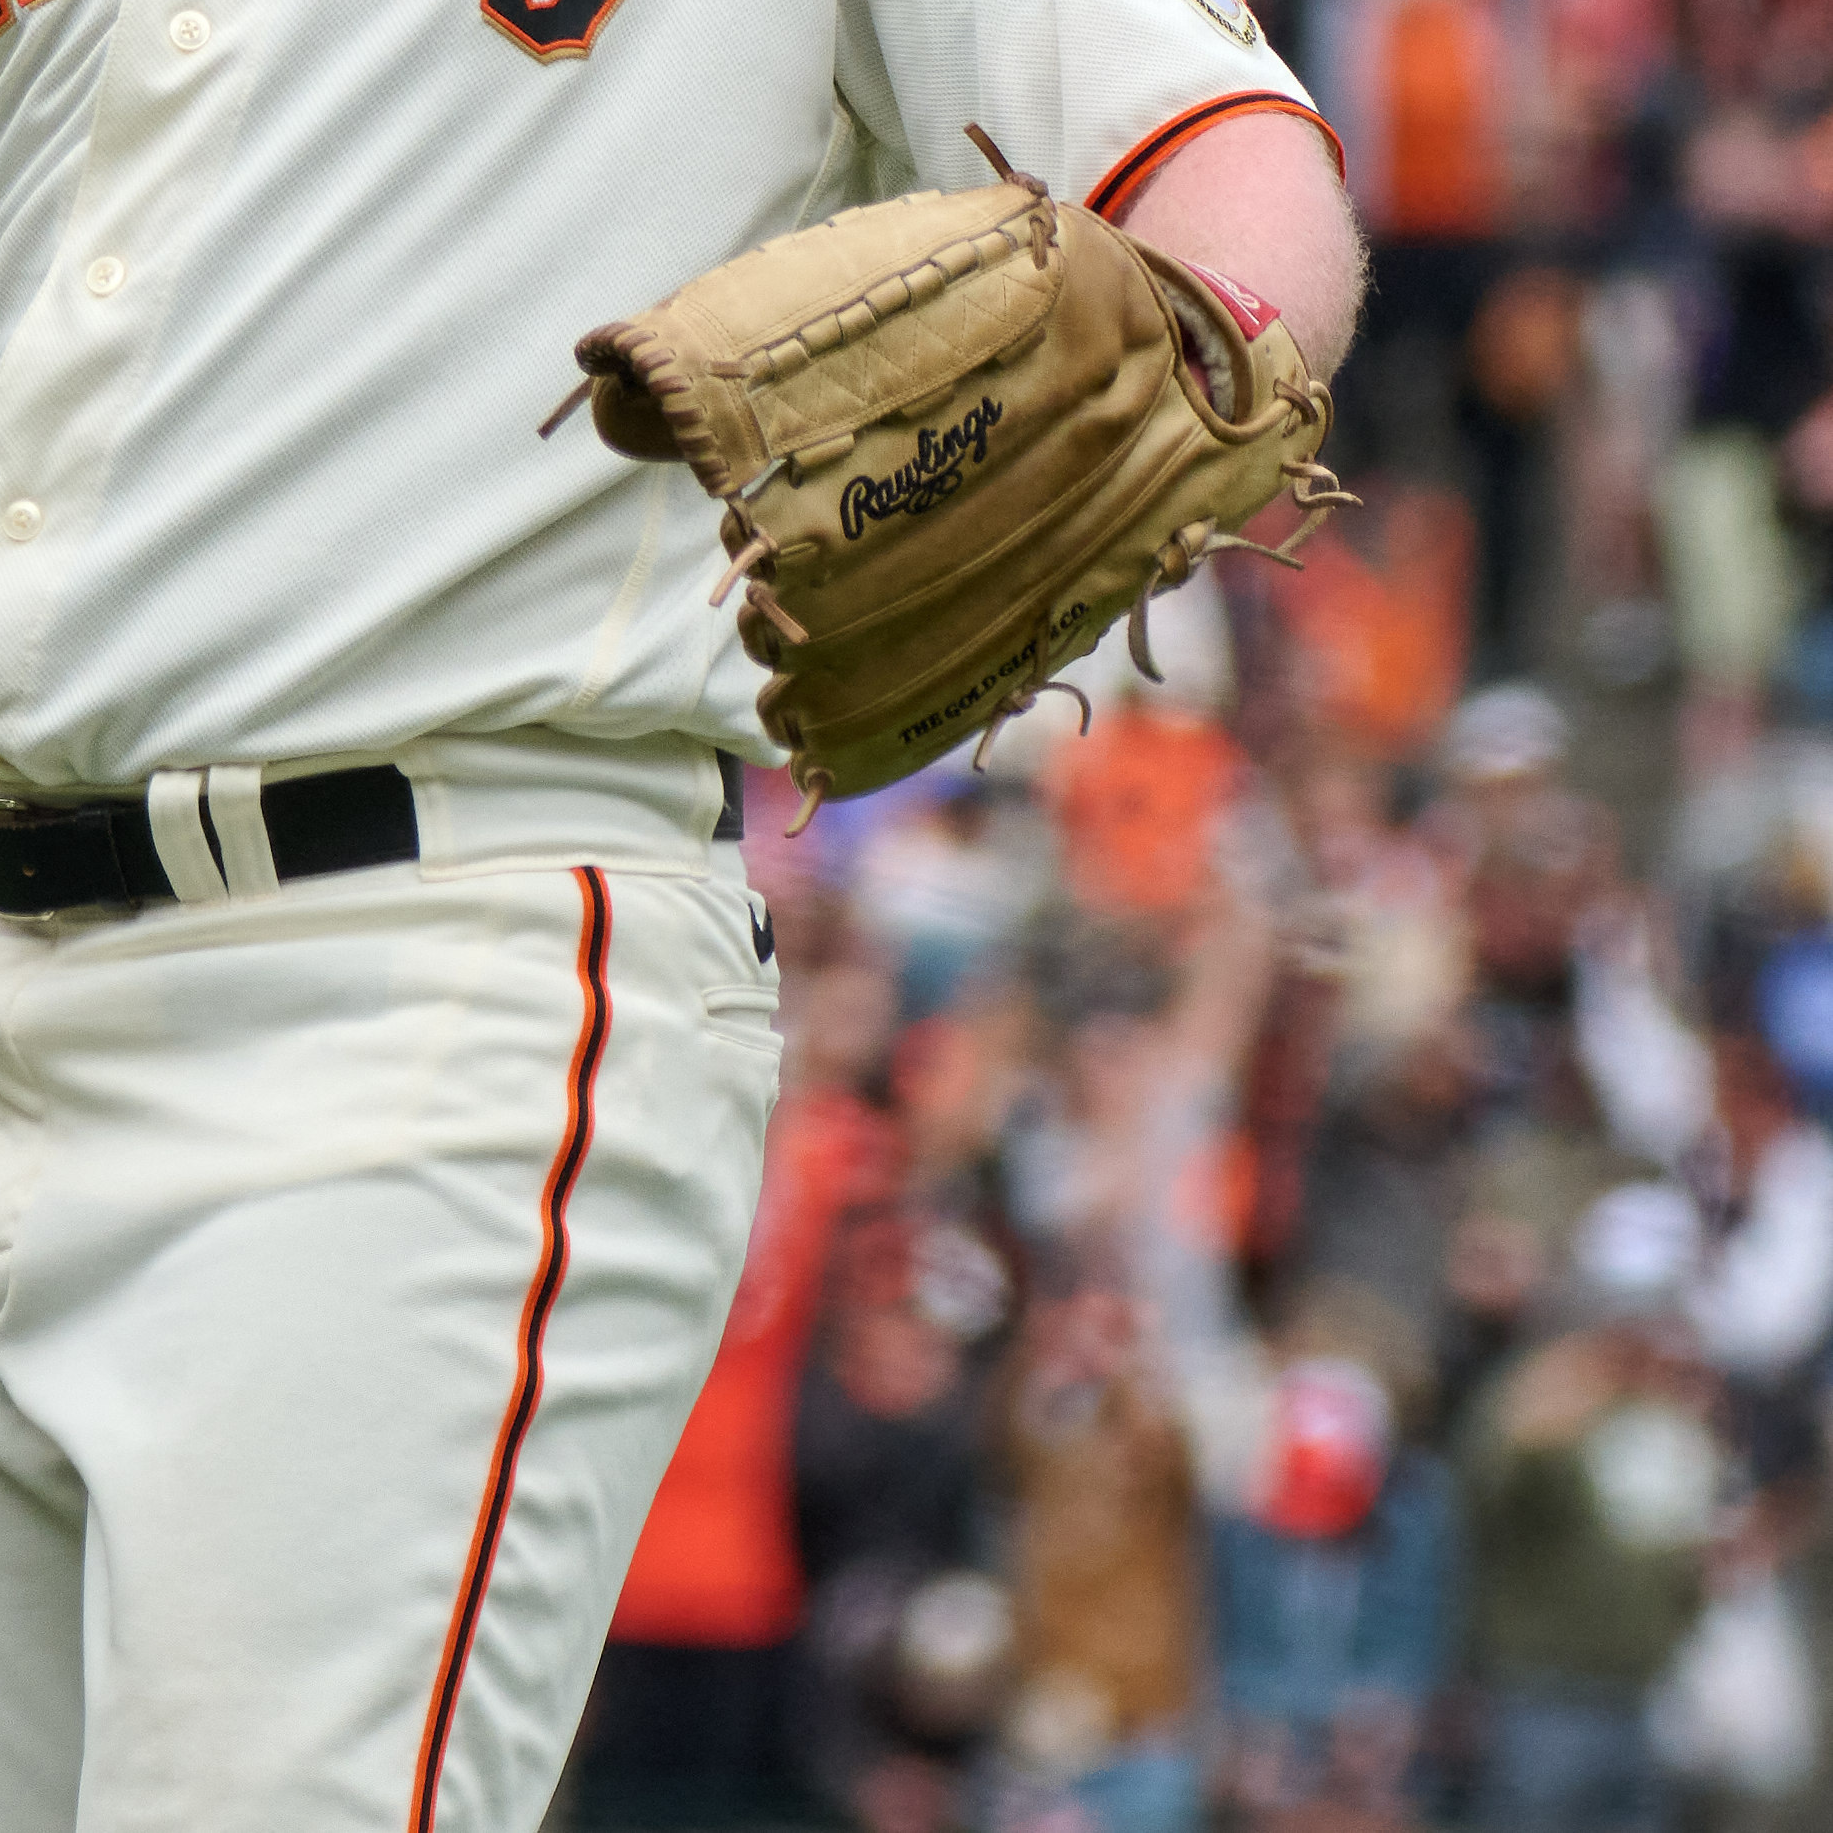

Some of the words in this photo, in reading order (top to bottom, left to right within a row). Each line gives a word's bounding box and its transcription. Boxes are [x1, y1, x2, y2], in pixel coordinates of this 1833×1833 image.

[839, 395, 1003, 541] Rawlings
[898, 711, 944, 745] THE
[944, 673, 998, 719] GOLD
